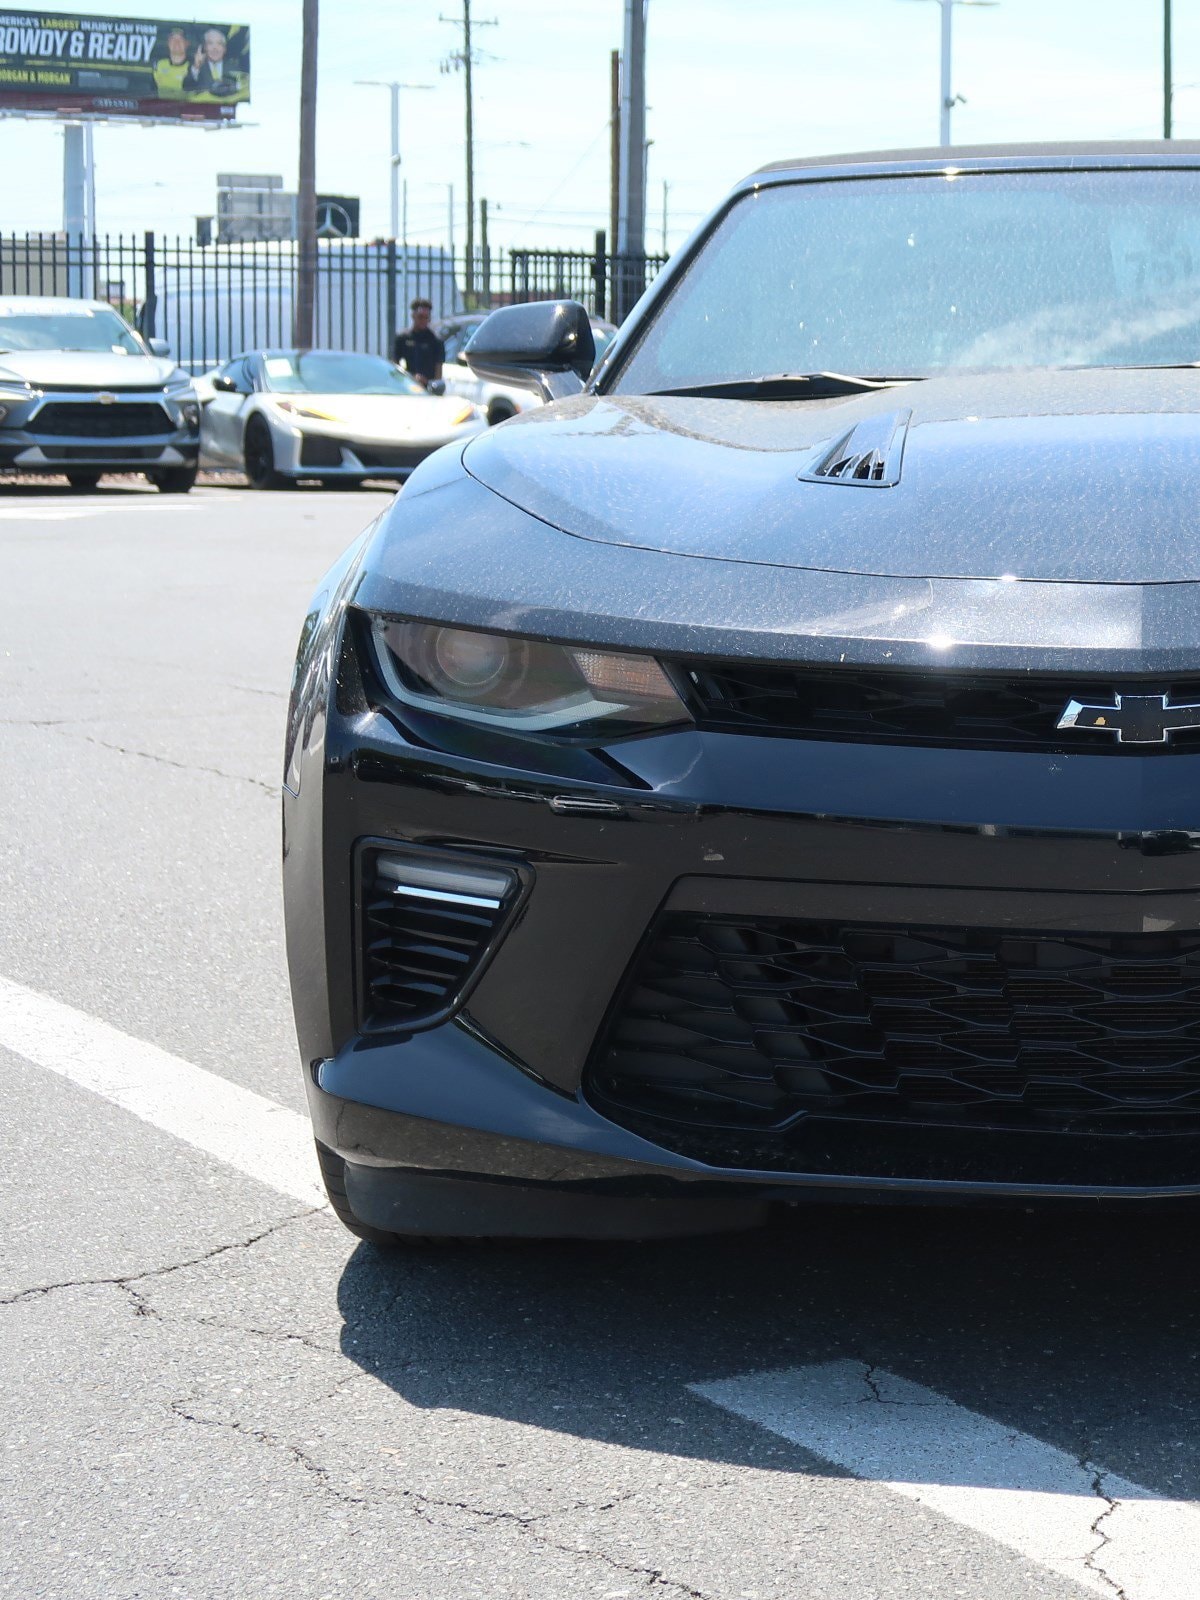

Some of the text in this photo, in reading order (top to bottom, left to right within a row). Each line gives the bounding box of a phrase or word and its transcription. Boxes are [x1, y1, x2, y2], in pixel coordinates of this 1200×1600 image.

[41, 18, 79, 30] LARGEST
[81, 21, 113, 32] INJURY
[115, 23, 134, 34] LAW
[70, 31, 85, 58] &
[88, 32, 157, 63] READY
[38, 71, 70, 85] MORGAN
